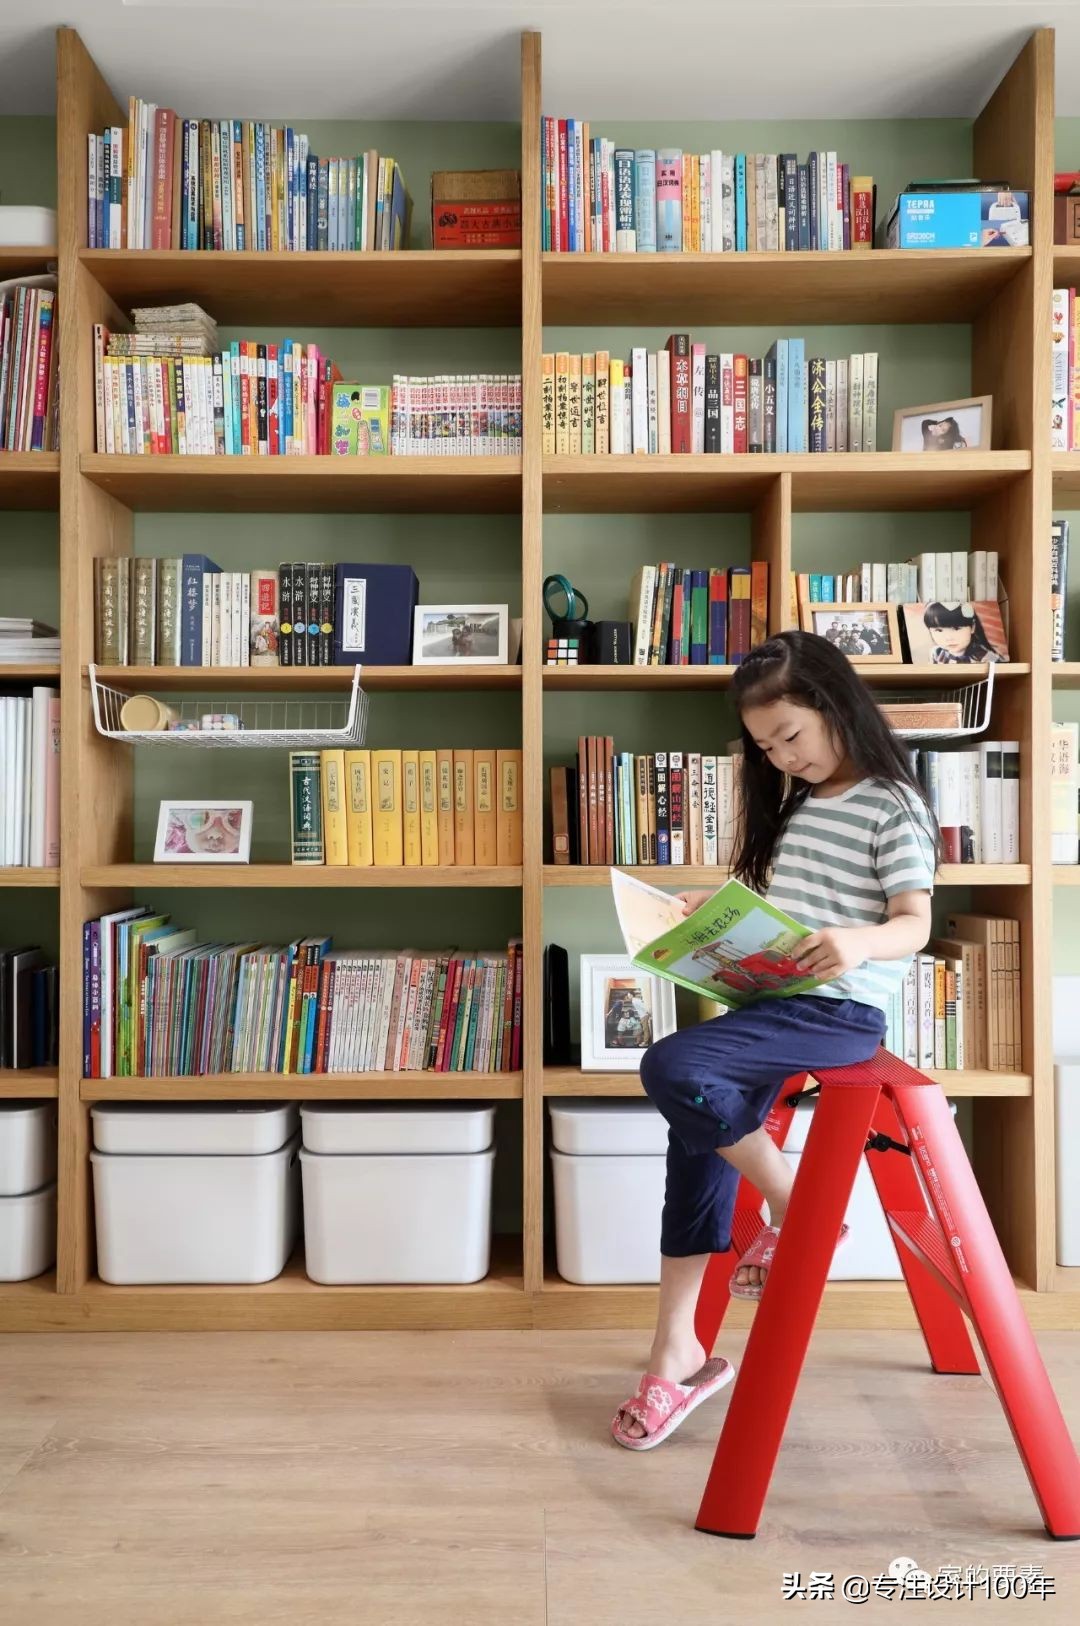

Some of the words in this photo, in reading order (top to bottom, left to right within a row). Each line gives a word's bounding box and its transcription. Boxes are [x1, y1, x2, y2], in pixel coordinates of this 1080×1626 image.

[907, 200, 934, 209] TEPRA
[694, 365, 705, 397] 左传
[811, 359, 826, 432] 济公全传
[707, 389, 719, 419] 品三国
[735, 380, 746, 431] 三国志
[765, 383, 775, 416] 小五义
[187, 576, 199, 612] 红楼梦
[282, 576, 291, 602] 水浒
[294, 576, 304, 602] 水浒
[657, 774, 667, 818] 图解心经
[671, 772, 682, 822] 图解山海经
